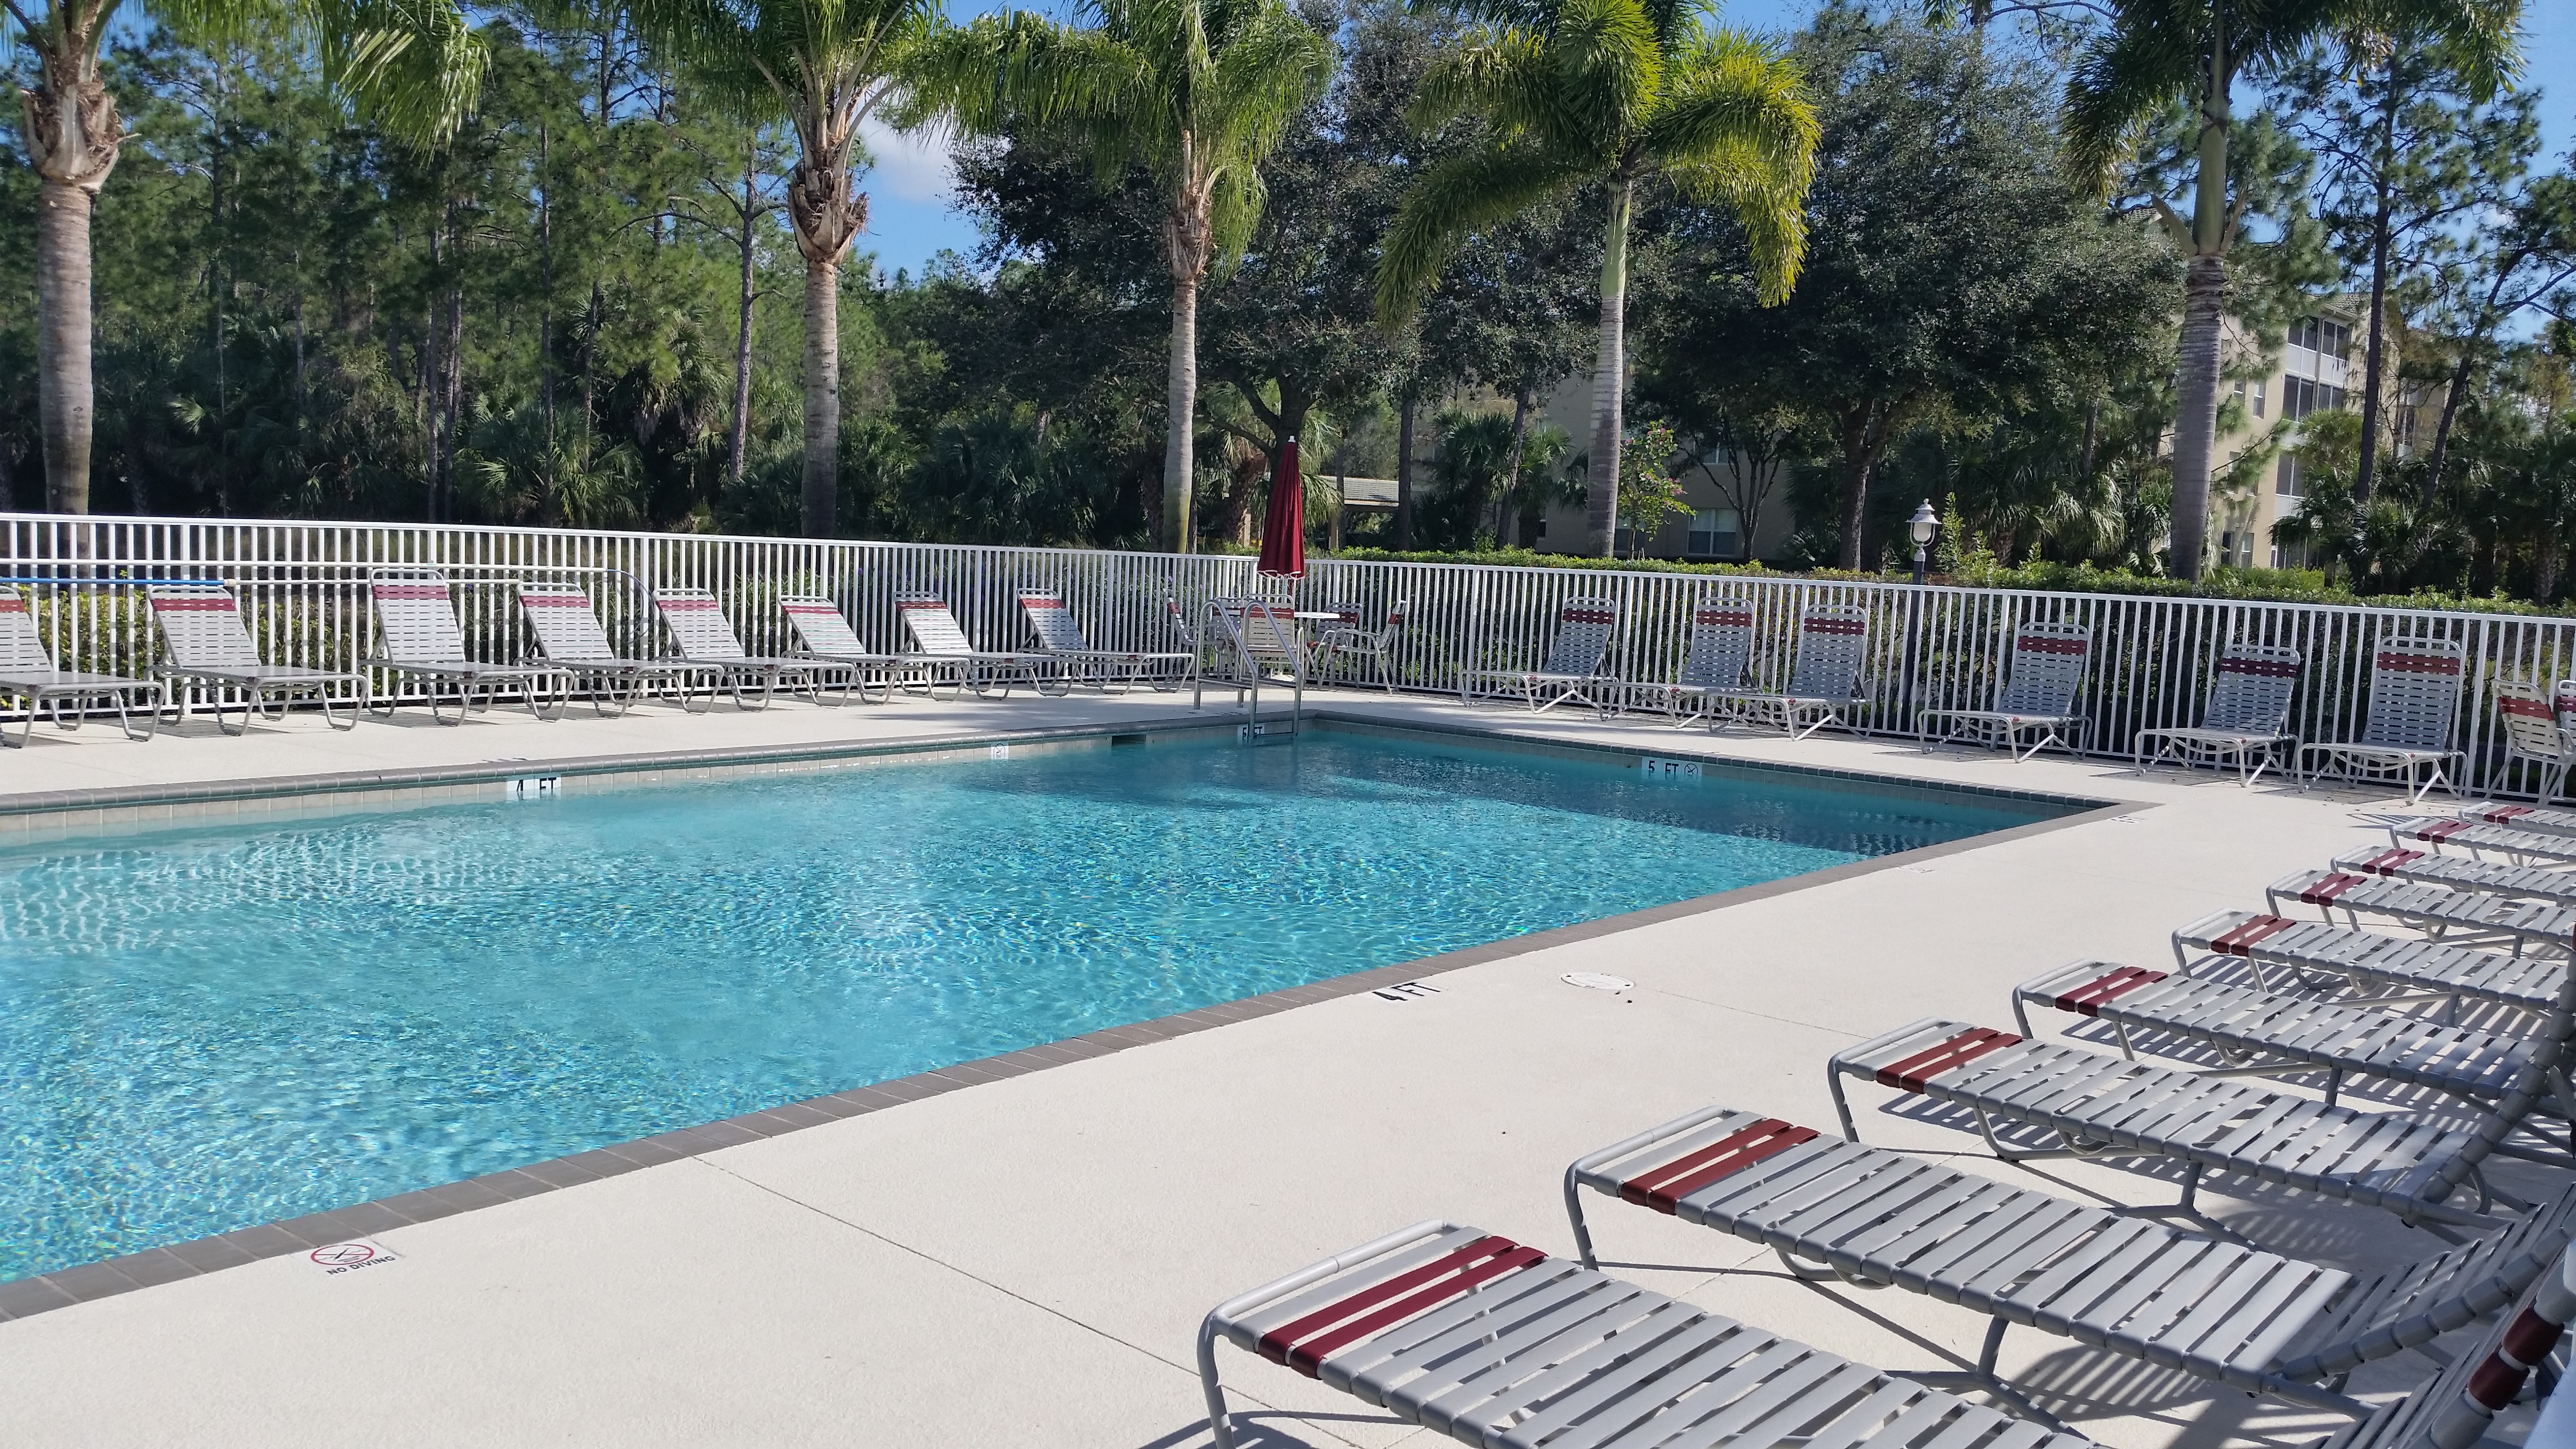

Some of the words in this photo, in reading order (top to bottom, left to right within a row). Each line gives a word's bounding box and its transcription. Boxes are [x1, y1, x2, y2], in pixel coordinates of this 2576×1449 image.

[1242, 727, 1247, 737] 5
[1648, 760, 1655, 771] 5
[1665, 762, 1679, 773] FT
[539, 777, 557, 790] FT
[1371, 991, 1408, 1001] 4
[1390, 982, 1441, 997] FT
[326, 1267, 347, 1275] NO
[349, 1255, 396, 1270] DIVING
